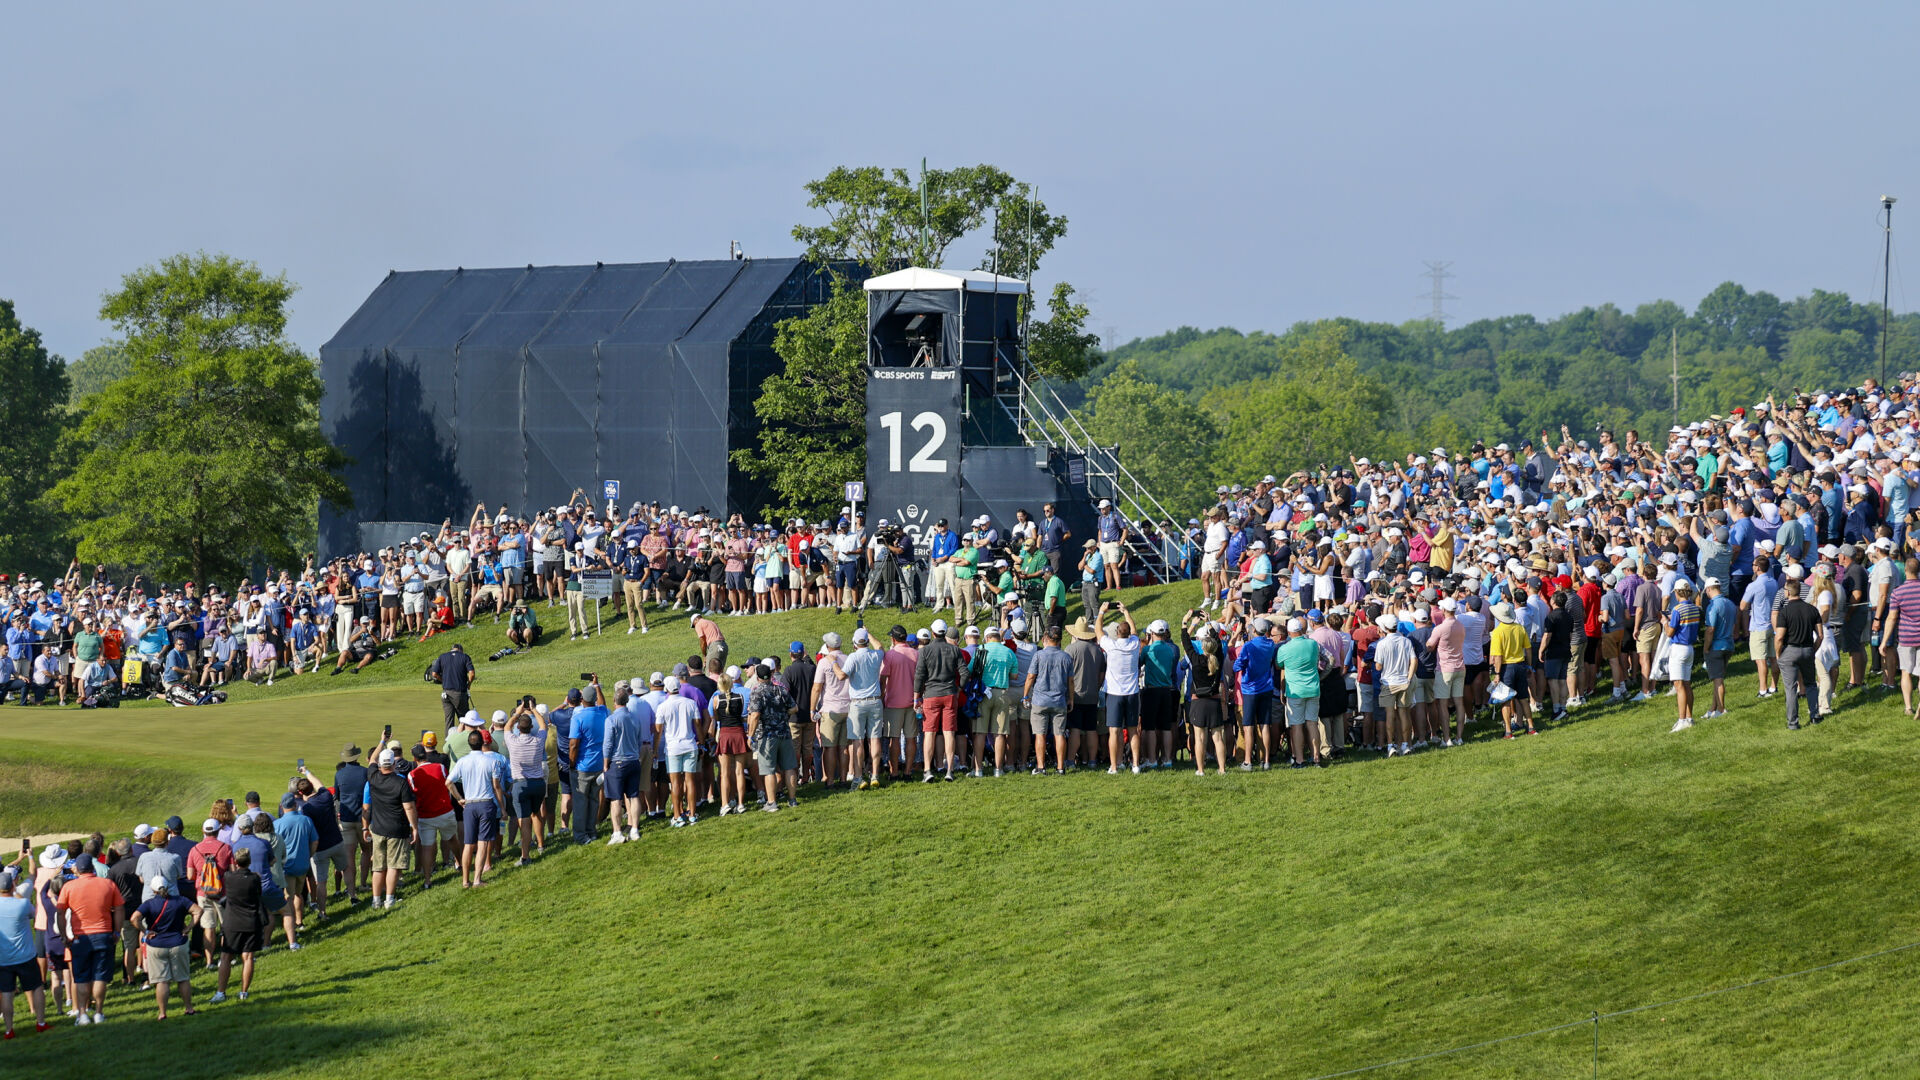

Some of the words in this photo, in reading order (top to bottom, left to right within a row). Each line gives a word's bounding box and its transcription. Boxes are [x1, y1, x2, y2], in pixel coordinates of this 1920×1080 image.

[880, 371, 895, 379] CBS
[895, 371, 925, 380] SPORTS
[930, 370, 956, 380] ESPN
[880, 411, 947, 473] 12
[847, 484, 860, 499] 12
[903, 524, 935, 546] GA
[914, 548, 931, 556] ERIC
